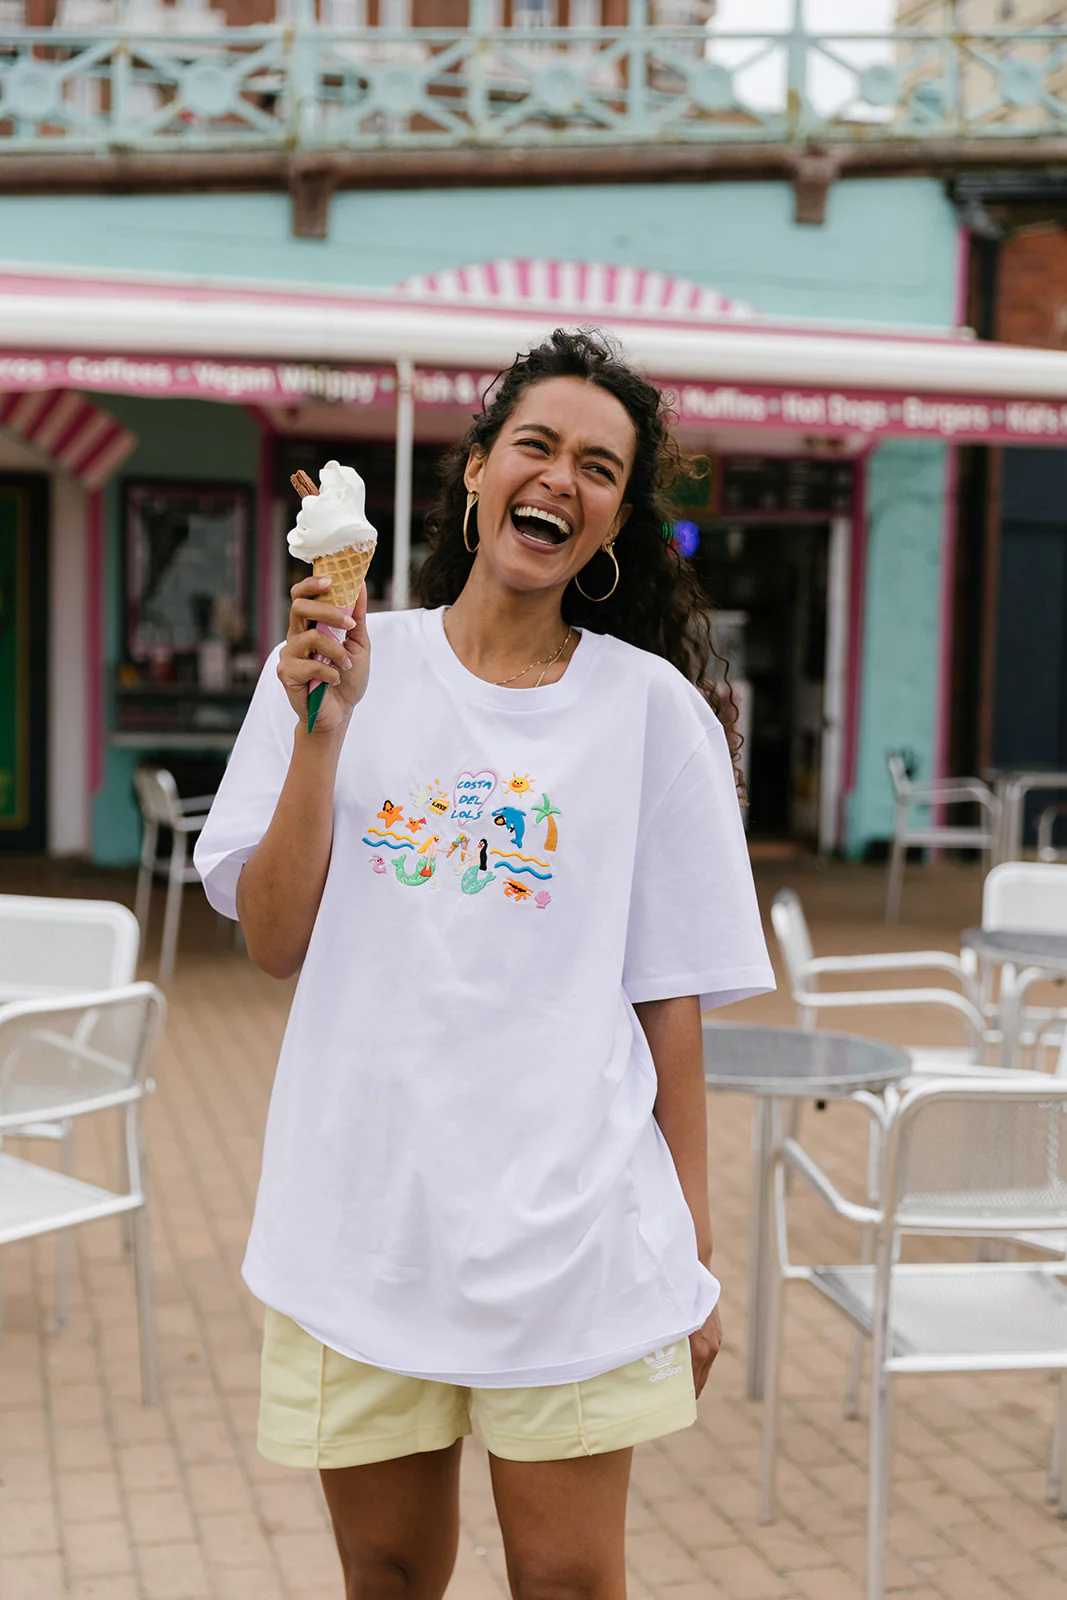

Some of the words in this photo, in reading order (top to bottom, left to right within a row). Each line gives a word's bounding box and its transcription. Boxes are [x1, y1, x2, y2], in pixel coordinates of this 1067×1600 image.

[67, 356, 172, 387] Coffees
[192, 361, 277, 395] Vegan
[277, 365, 377, 404] Whippy
[412, 370, 454, 403] ish
[454, 372, 476, 405] &
[681, 386, 768, 422] Muffins
[781, 391, 827, 424] Hot
[828, 393, 890, 432] Dogs
[902, 396, 989, 435] Burgers
[456, 780, 493, 790] COSTA
[458, 795, 482, 805] DEL
[451, 809, 483, 820] LOLS
[648, 1366, 683, 1382] adidas
